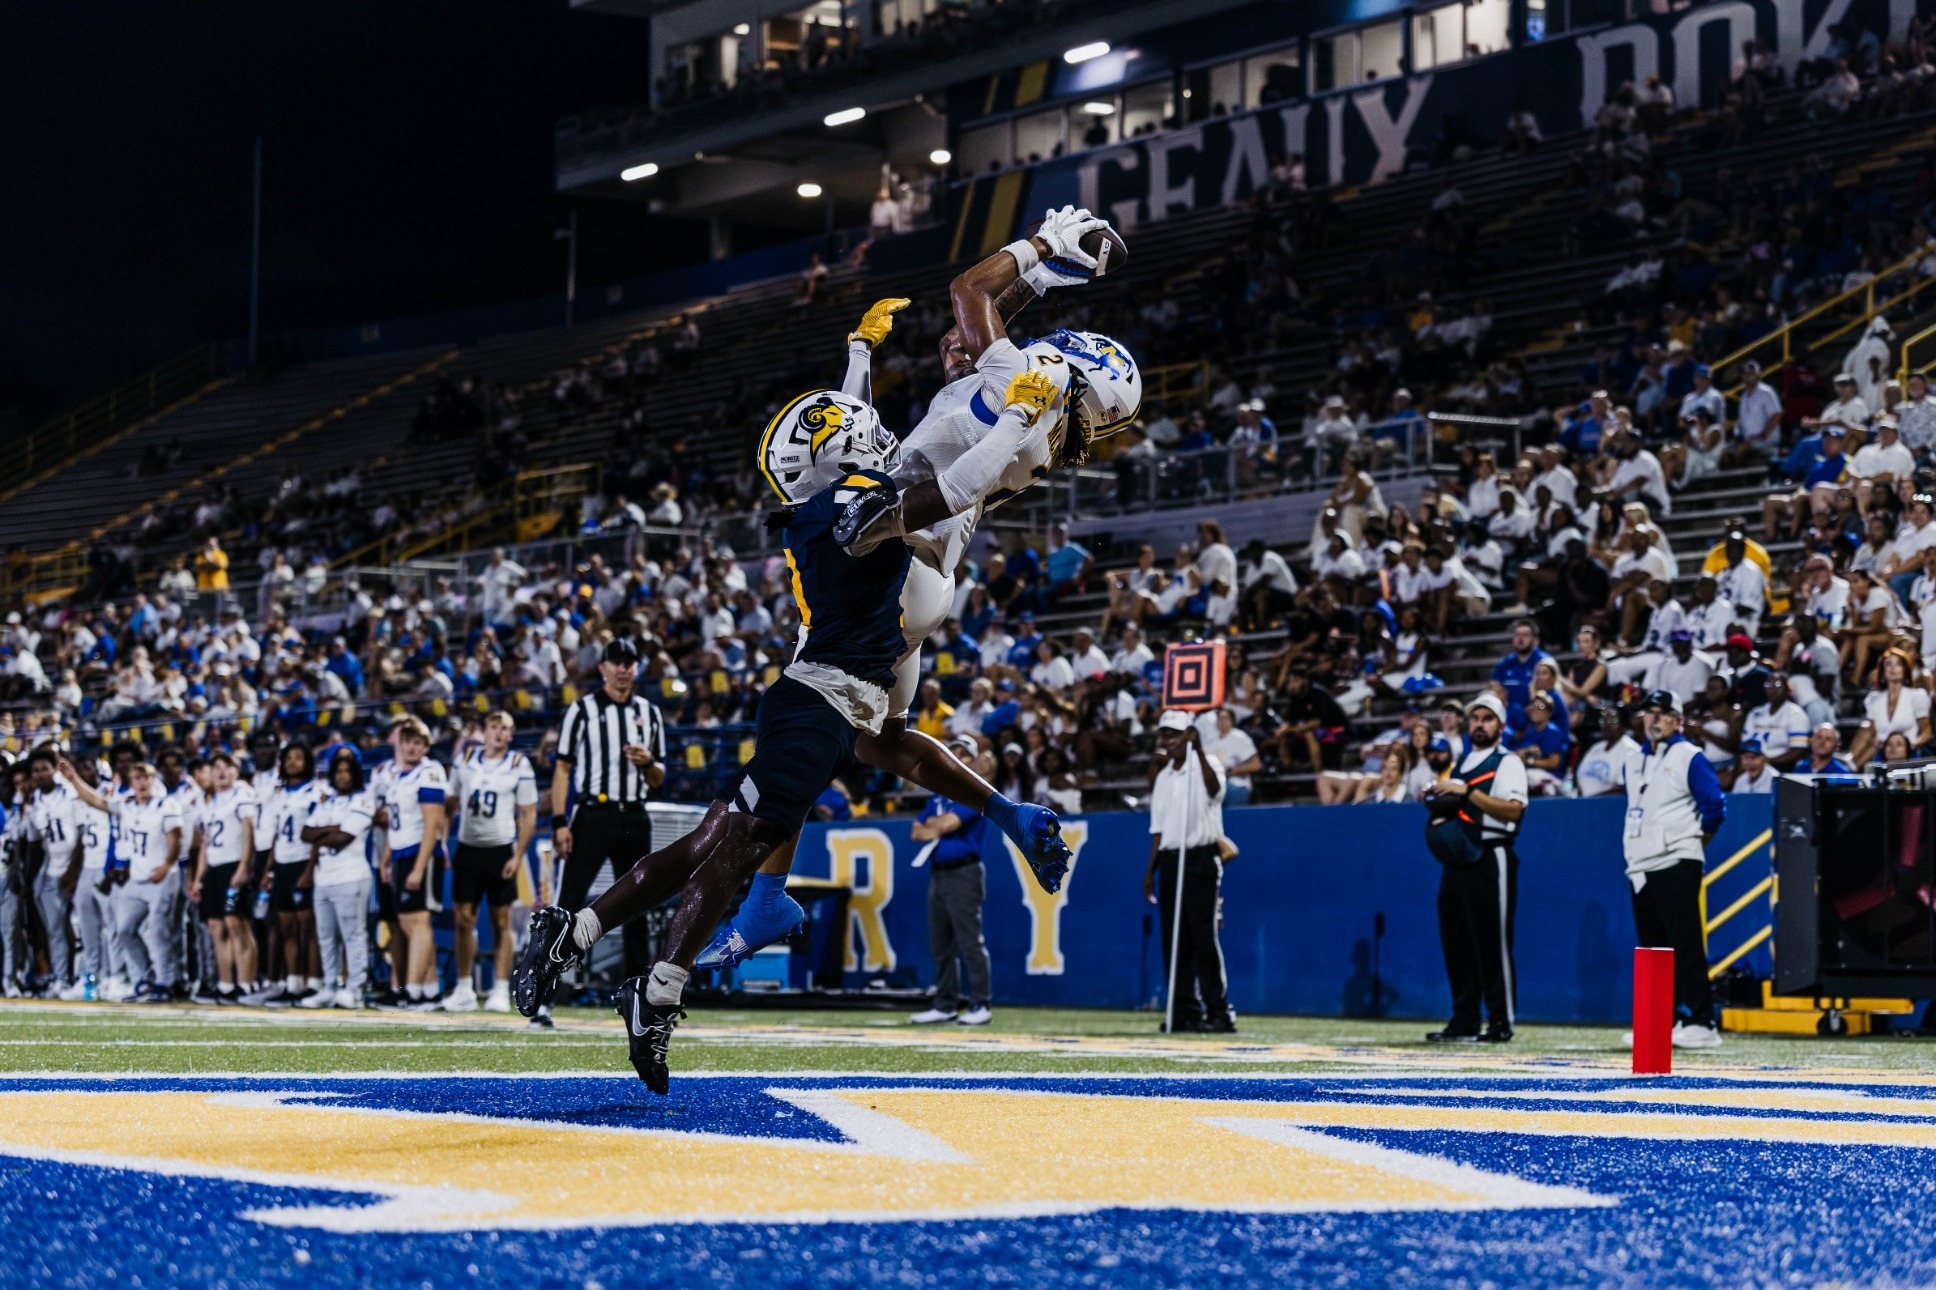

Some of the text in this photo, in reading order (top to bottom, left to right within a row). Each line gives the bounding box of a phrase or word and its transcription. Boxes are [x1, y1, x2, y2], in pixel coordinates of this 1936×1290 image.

[1077, 75, 1434, 235] GEAUX
[1036, 354, 1064, 366] 2
[468, 789, 497, 818] 49
